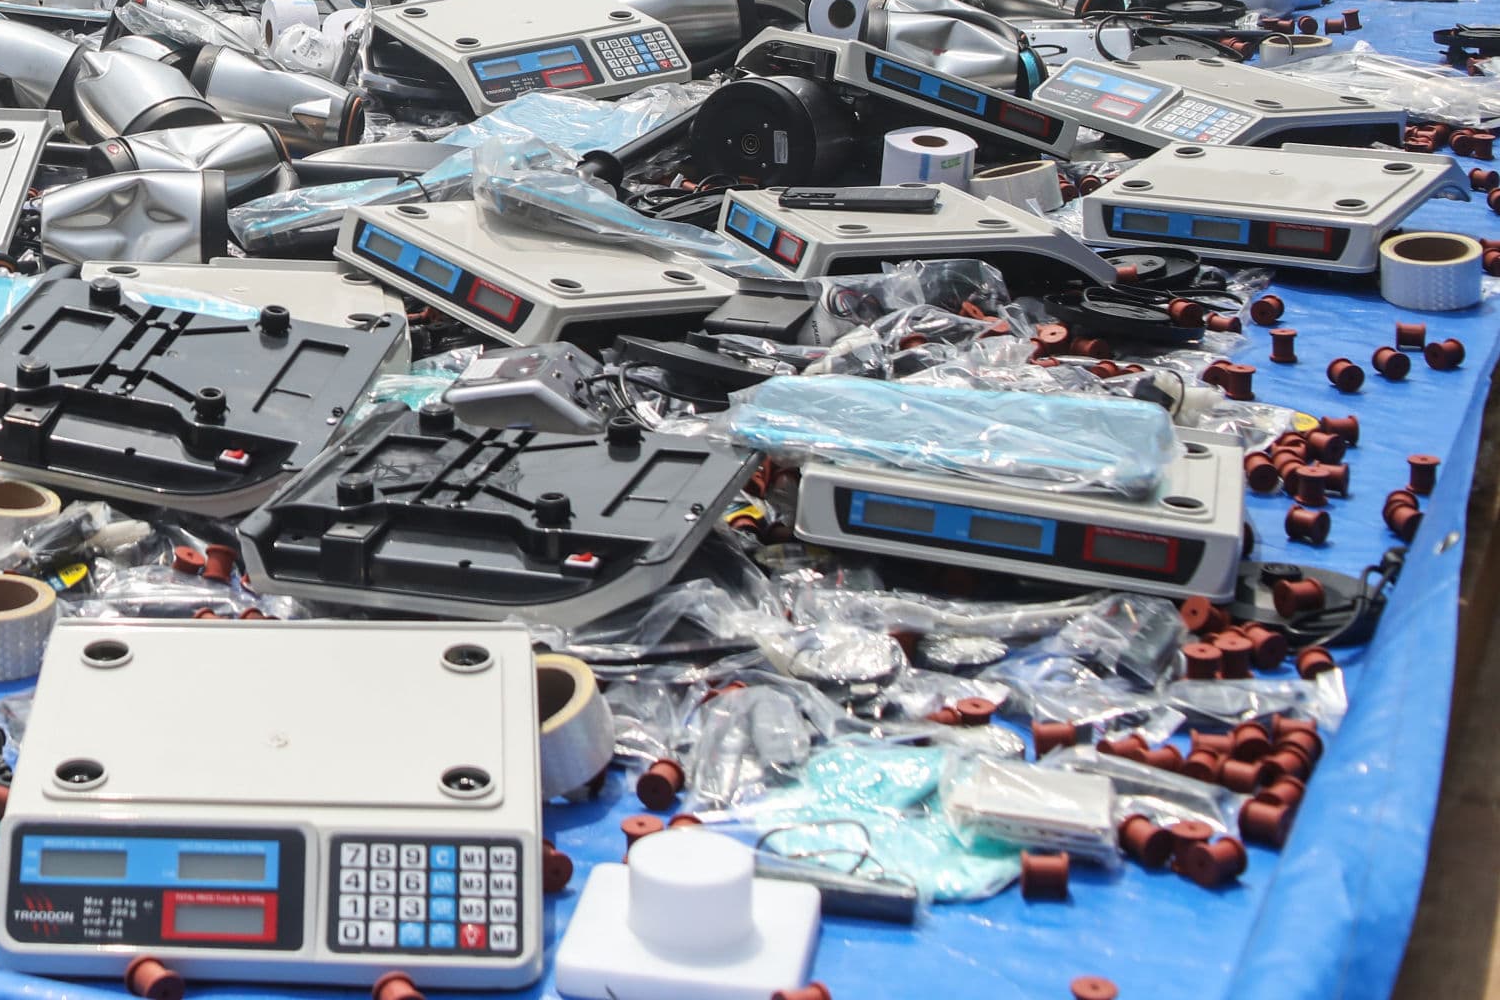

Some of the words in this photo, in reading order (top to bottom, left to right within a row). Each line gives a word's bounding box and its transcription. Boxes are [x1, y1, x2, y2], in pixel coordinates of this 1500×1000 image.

[347, 846, 360, 863] 7
[376, 848, 391, 864] 8
[405, 848, 420, 865] 9
[436, 850, 449, 865] C
[463, 852, 483, 865] M1
[492, 852, 512, 865] M2
[345, 873, 360, 889] 4
[375, 874, 390, 890] 5
[405, 875, 420, 890] 6
[463, 878, 483, 891] M3
[492, 878, 512, 891] M4
[13, 909, 75, 924] TROODON
[348, 899, 358, 915] 1
[375, 900, 390, 916] 2
[405, 900, 420, 917] 3
[463, 903, 483, 916] M5
[492, 904, 512, 917] M6
[343, 925, 359, 941] 0
[492, 929, 512, 943] M7
